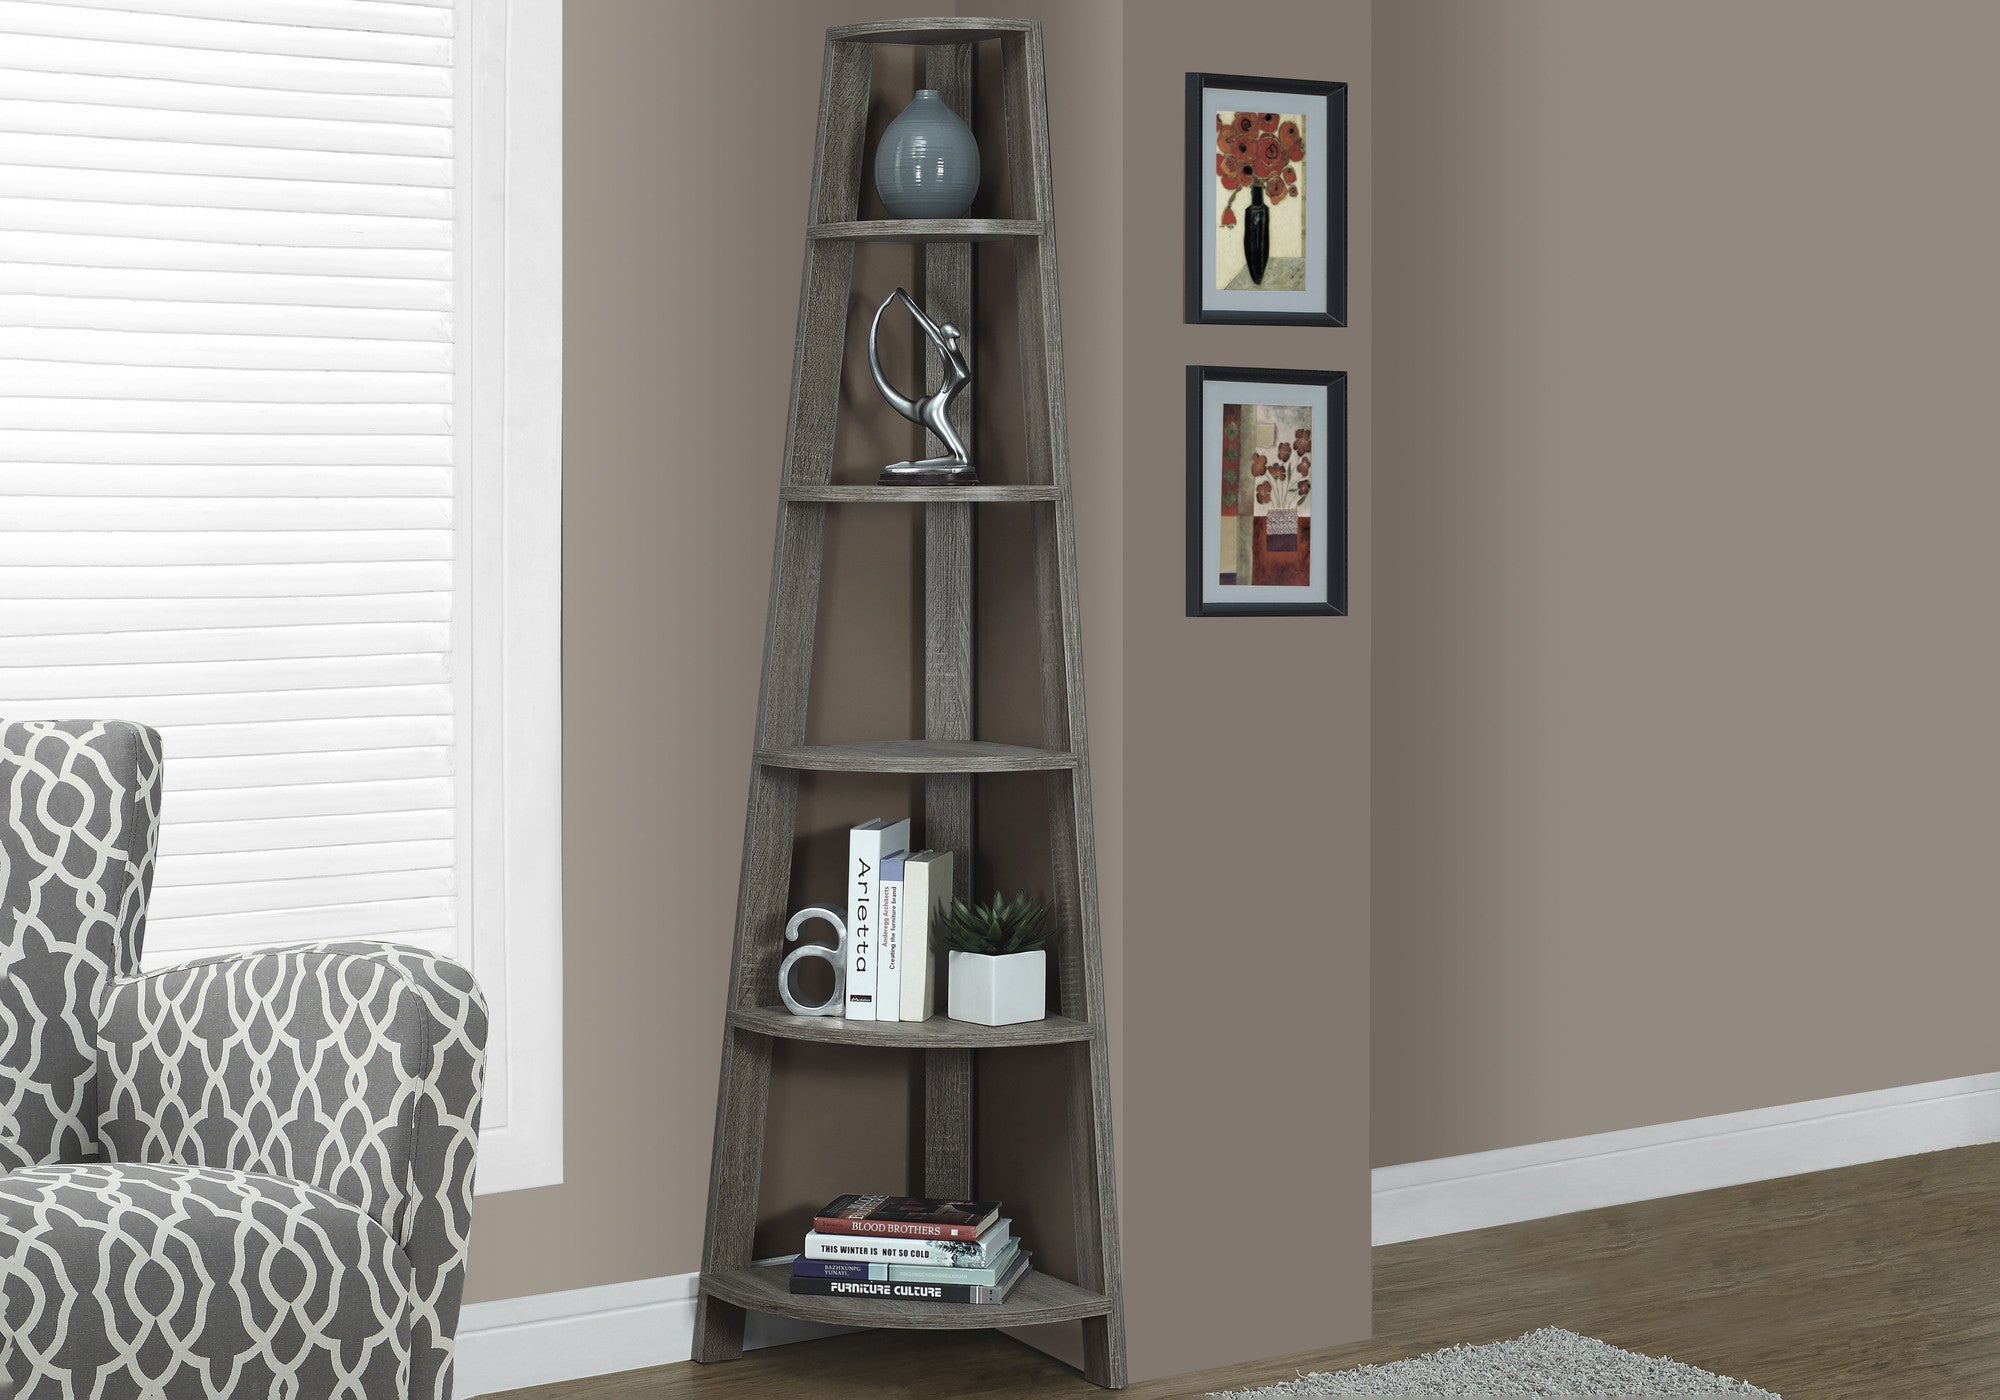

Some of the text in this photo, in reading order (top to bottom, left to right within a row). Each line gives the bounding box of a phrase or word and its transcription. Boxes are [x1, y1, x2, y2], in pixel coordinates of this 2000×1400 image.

[856, 857, 871, 973] Arletta
[852, 1221, 886, 1232] BLOOD
[887, 1224, 941, 1236] BROTHERS
[821, 1244, 930, 1258] THIS WINTER IS NOT SO COLD
[894, 1286, 942, 1298] CULTURE
